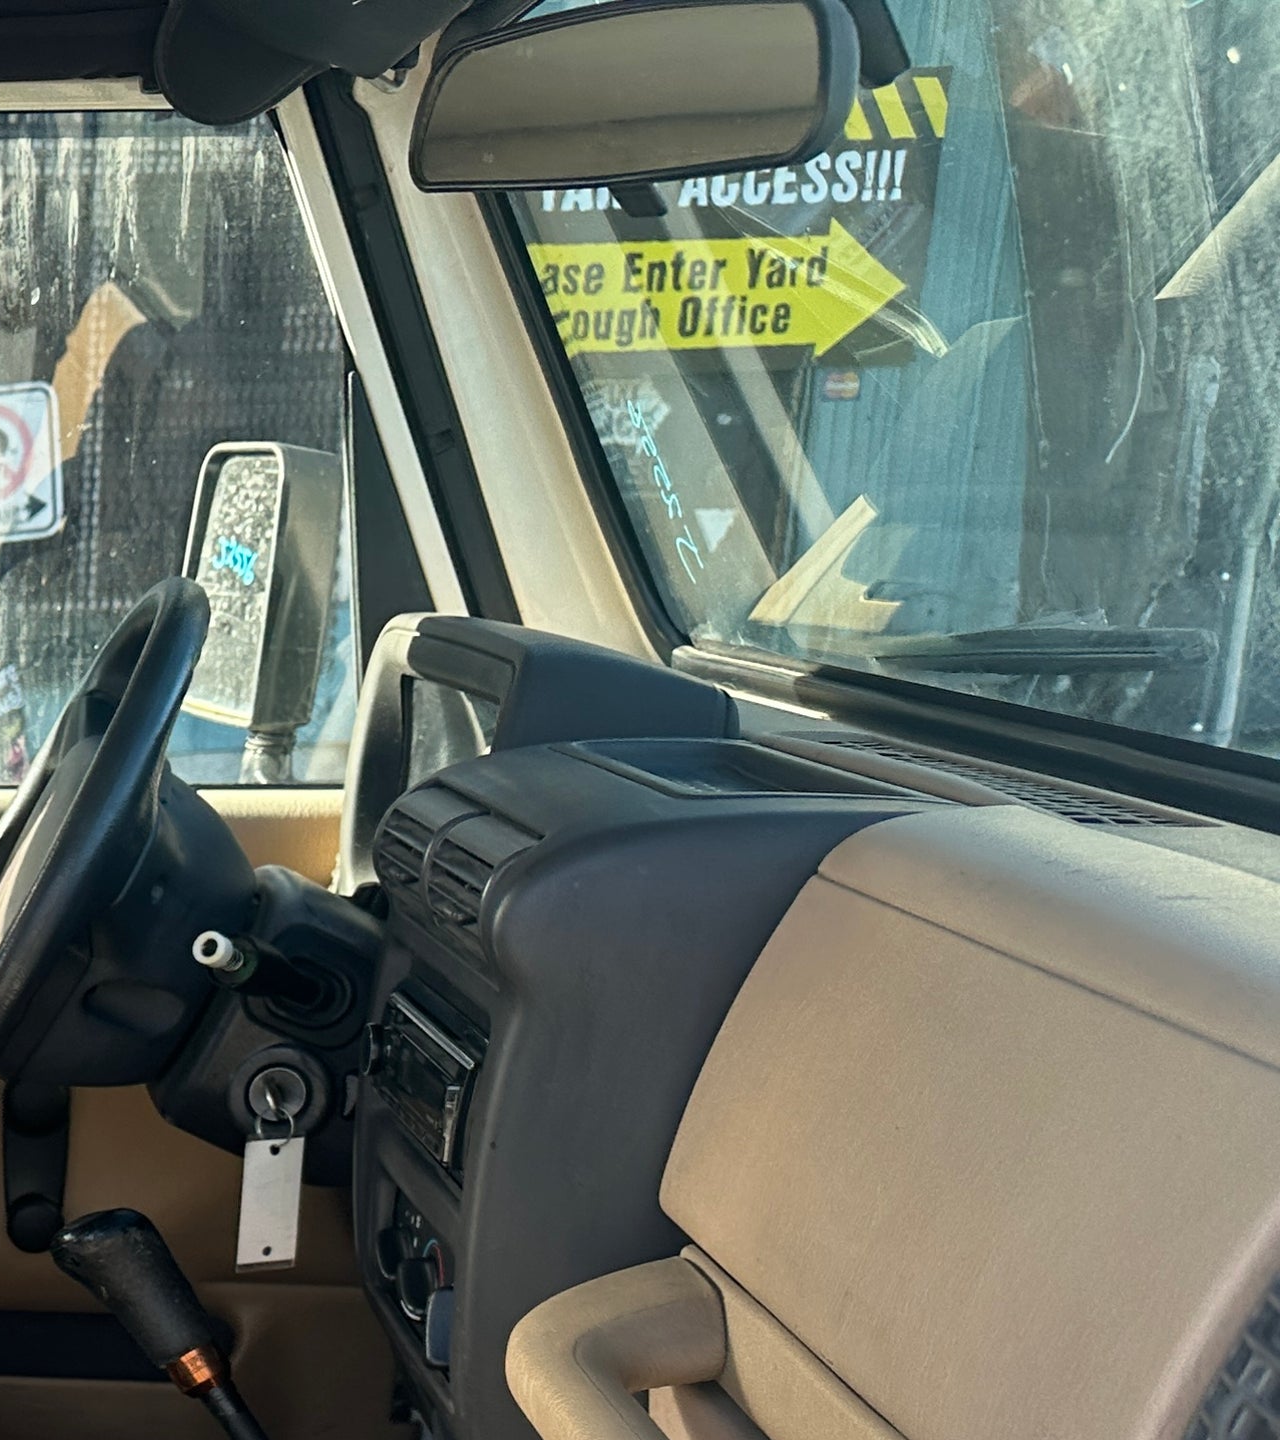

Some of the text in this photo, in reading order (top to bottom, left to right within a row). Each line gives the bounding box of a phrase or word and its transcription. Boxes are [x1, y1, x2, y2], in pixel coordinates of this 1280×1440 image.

[623, 251, 727, 294] Enter
[747, 246, 829, 289] Yard
[678, 296, 791, 338] Office
